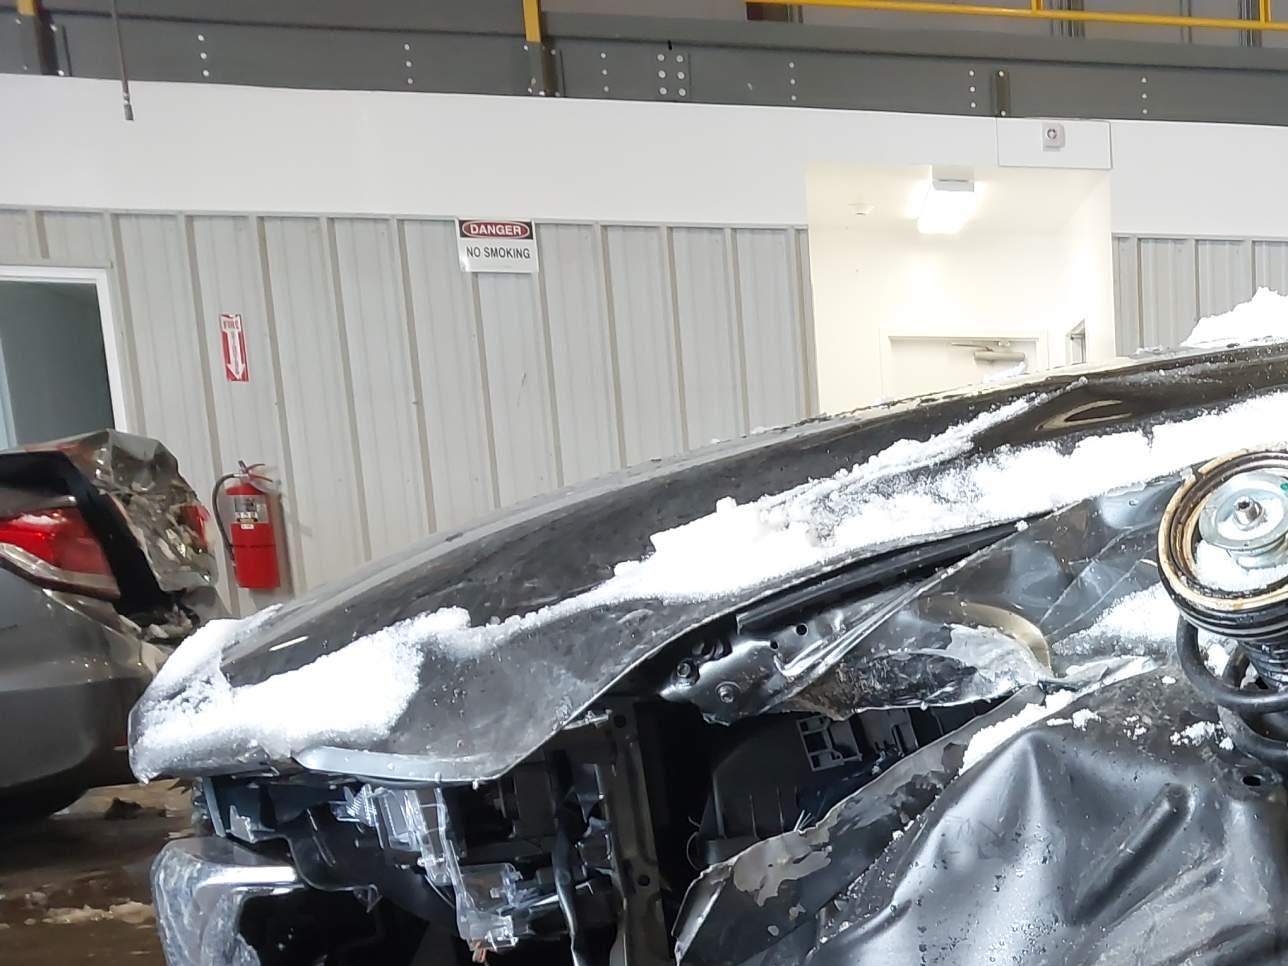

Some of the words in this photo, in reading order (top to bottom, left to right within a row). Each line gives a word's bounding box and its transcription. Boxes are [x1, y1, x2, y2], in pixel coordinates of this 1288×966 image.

[470, 224, 522, 236] DANGER
[466, 246, 481, 258] NO
[483, 246, 531, 259] SMOKING
